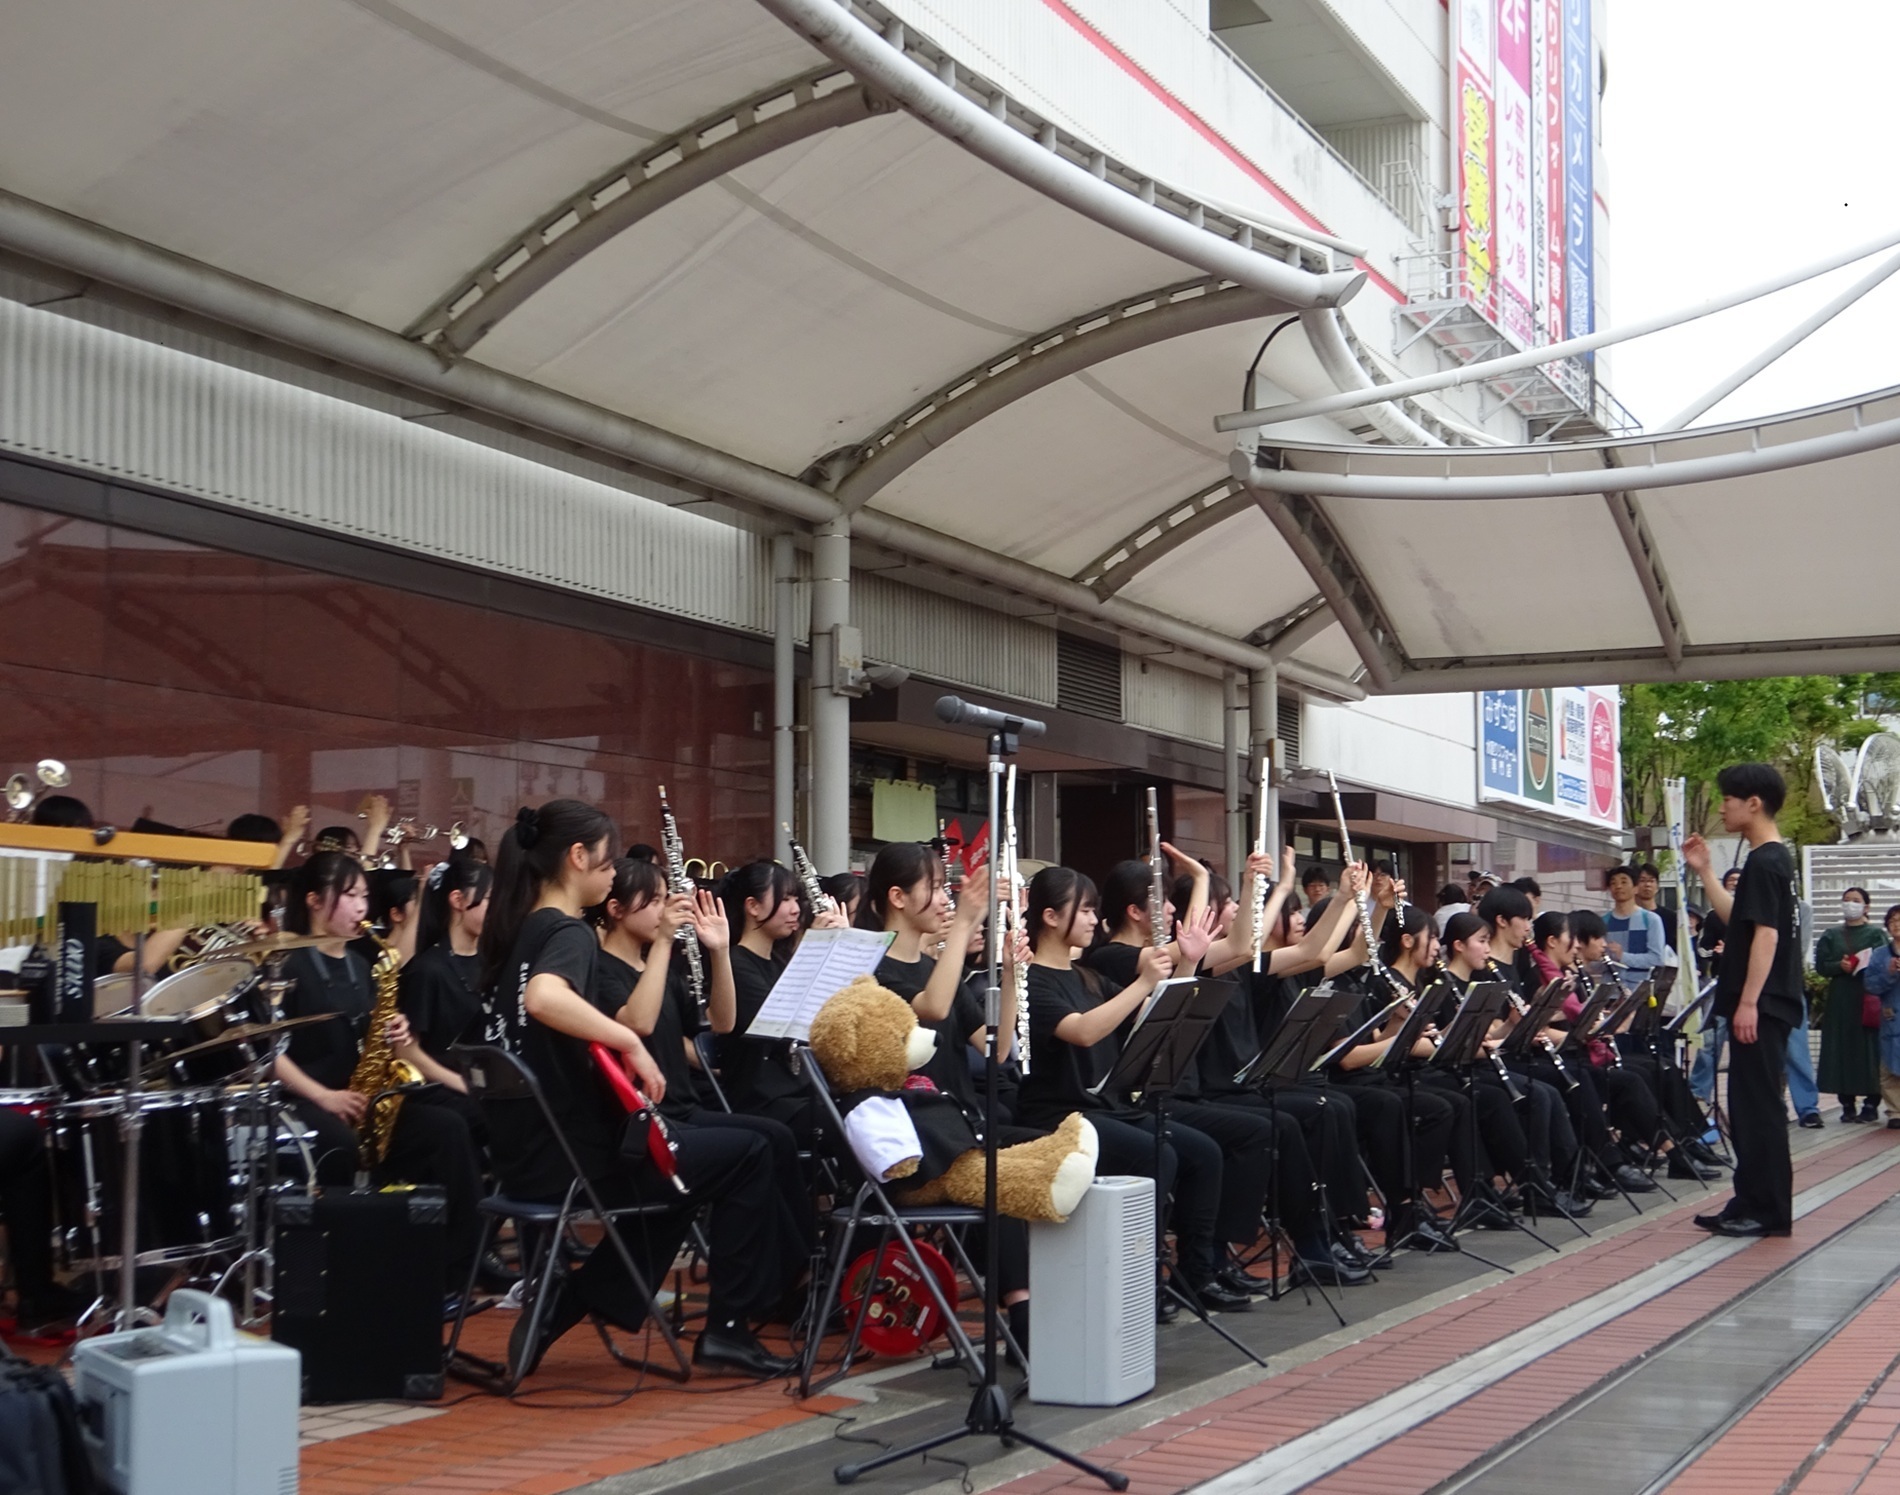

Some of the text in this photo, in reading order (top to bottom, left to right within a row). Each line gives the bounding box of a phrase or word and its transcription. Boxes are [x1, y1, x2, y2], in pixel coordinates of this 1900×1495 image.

[1504, 85, 1515, 266] レッスン
[1514, 99, 1526, 282] 無料体験
